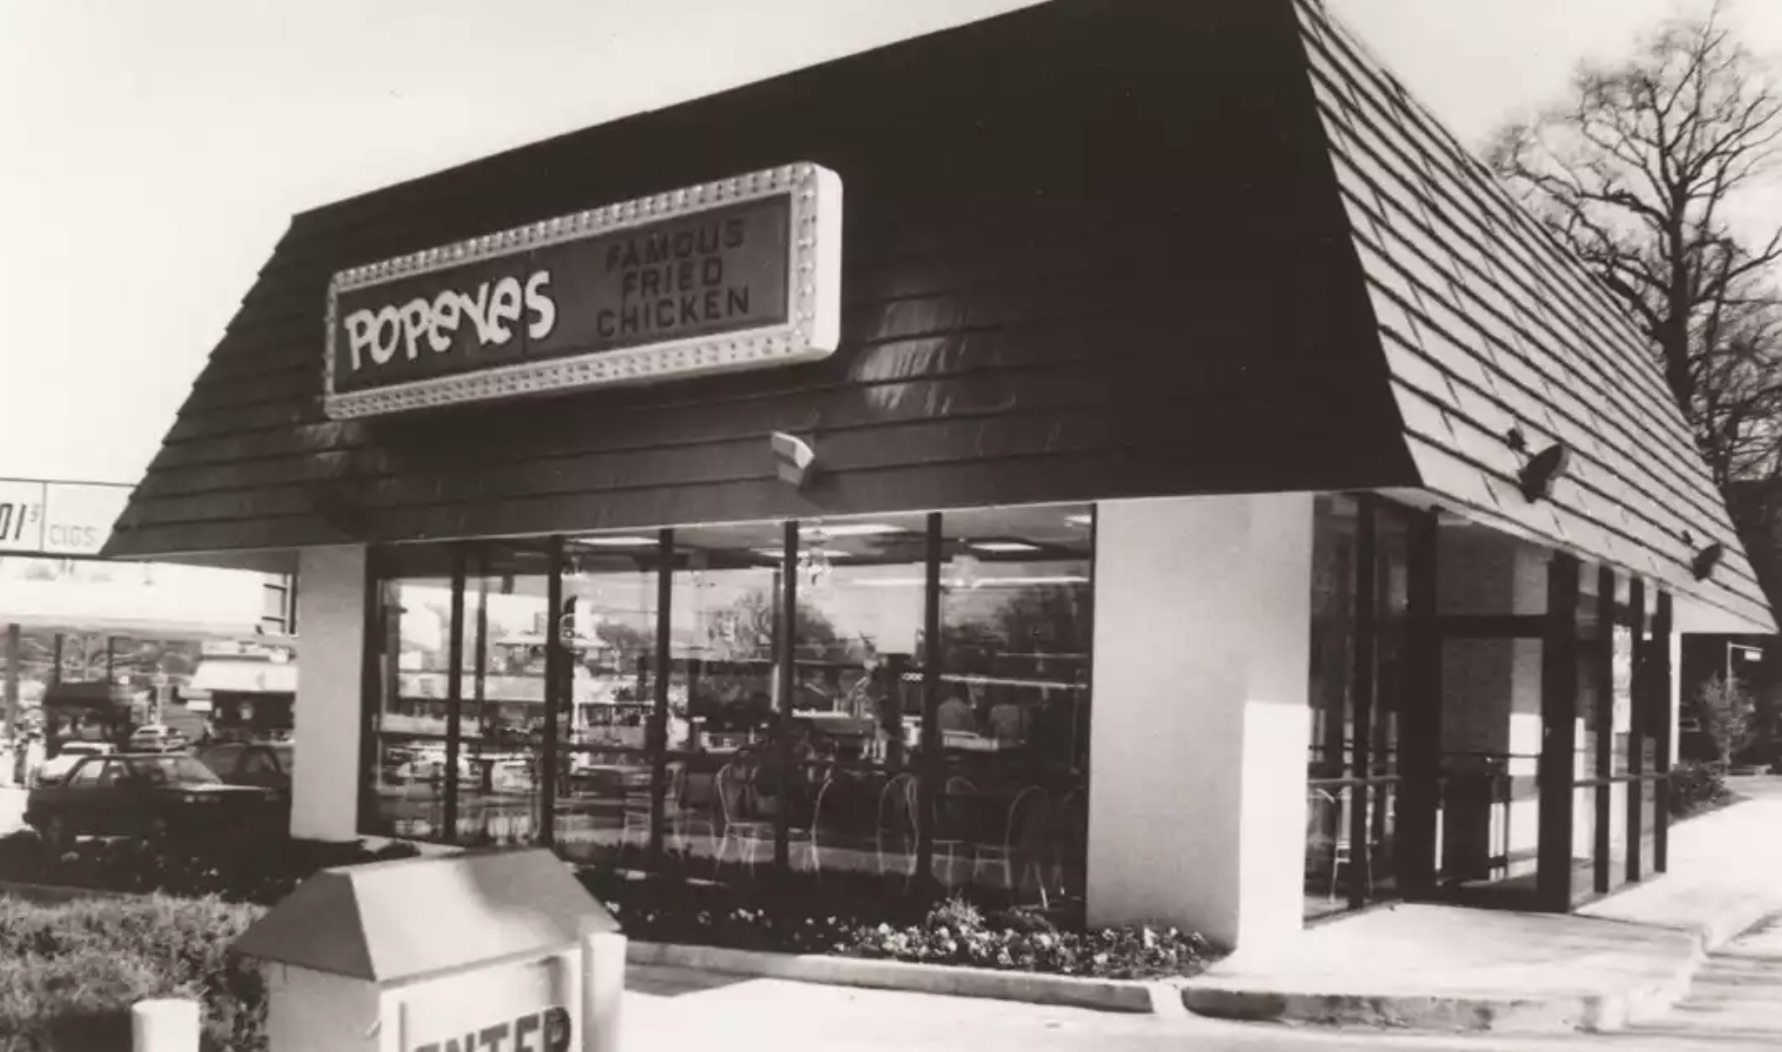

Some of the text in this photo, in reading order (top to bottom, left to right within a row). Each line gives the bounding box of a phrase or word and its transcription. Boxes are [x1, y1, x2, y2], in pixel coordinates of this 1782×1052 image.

[606, 218, 745, 274] FAMOUS
[621, 255, 723, 302] FRIED
[597, 282, 750, 338] CHICKEN
[49, 523, 99, 547] CIGS
